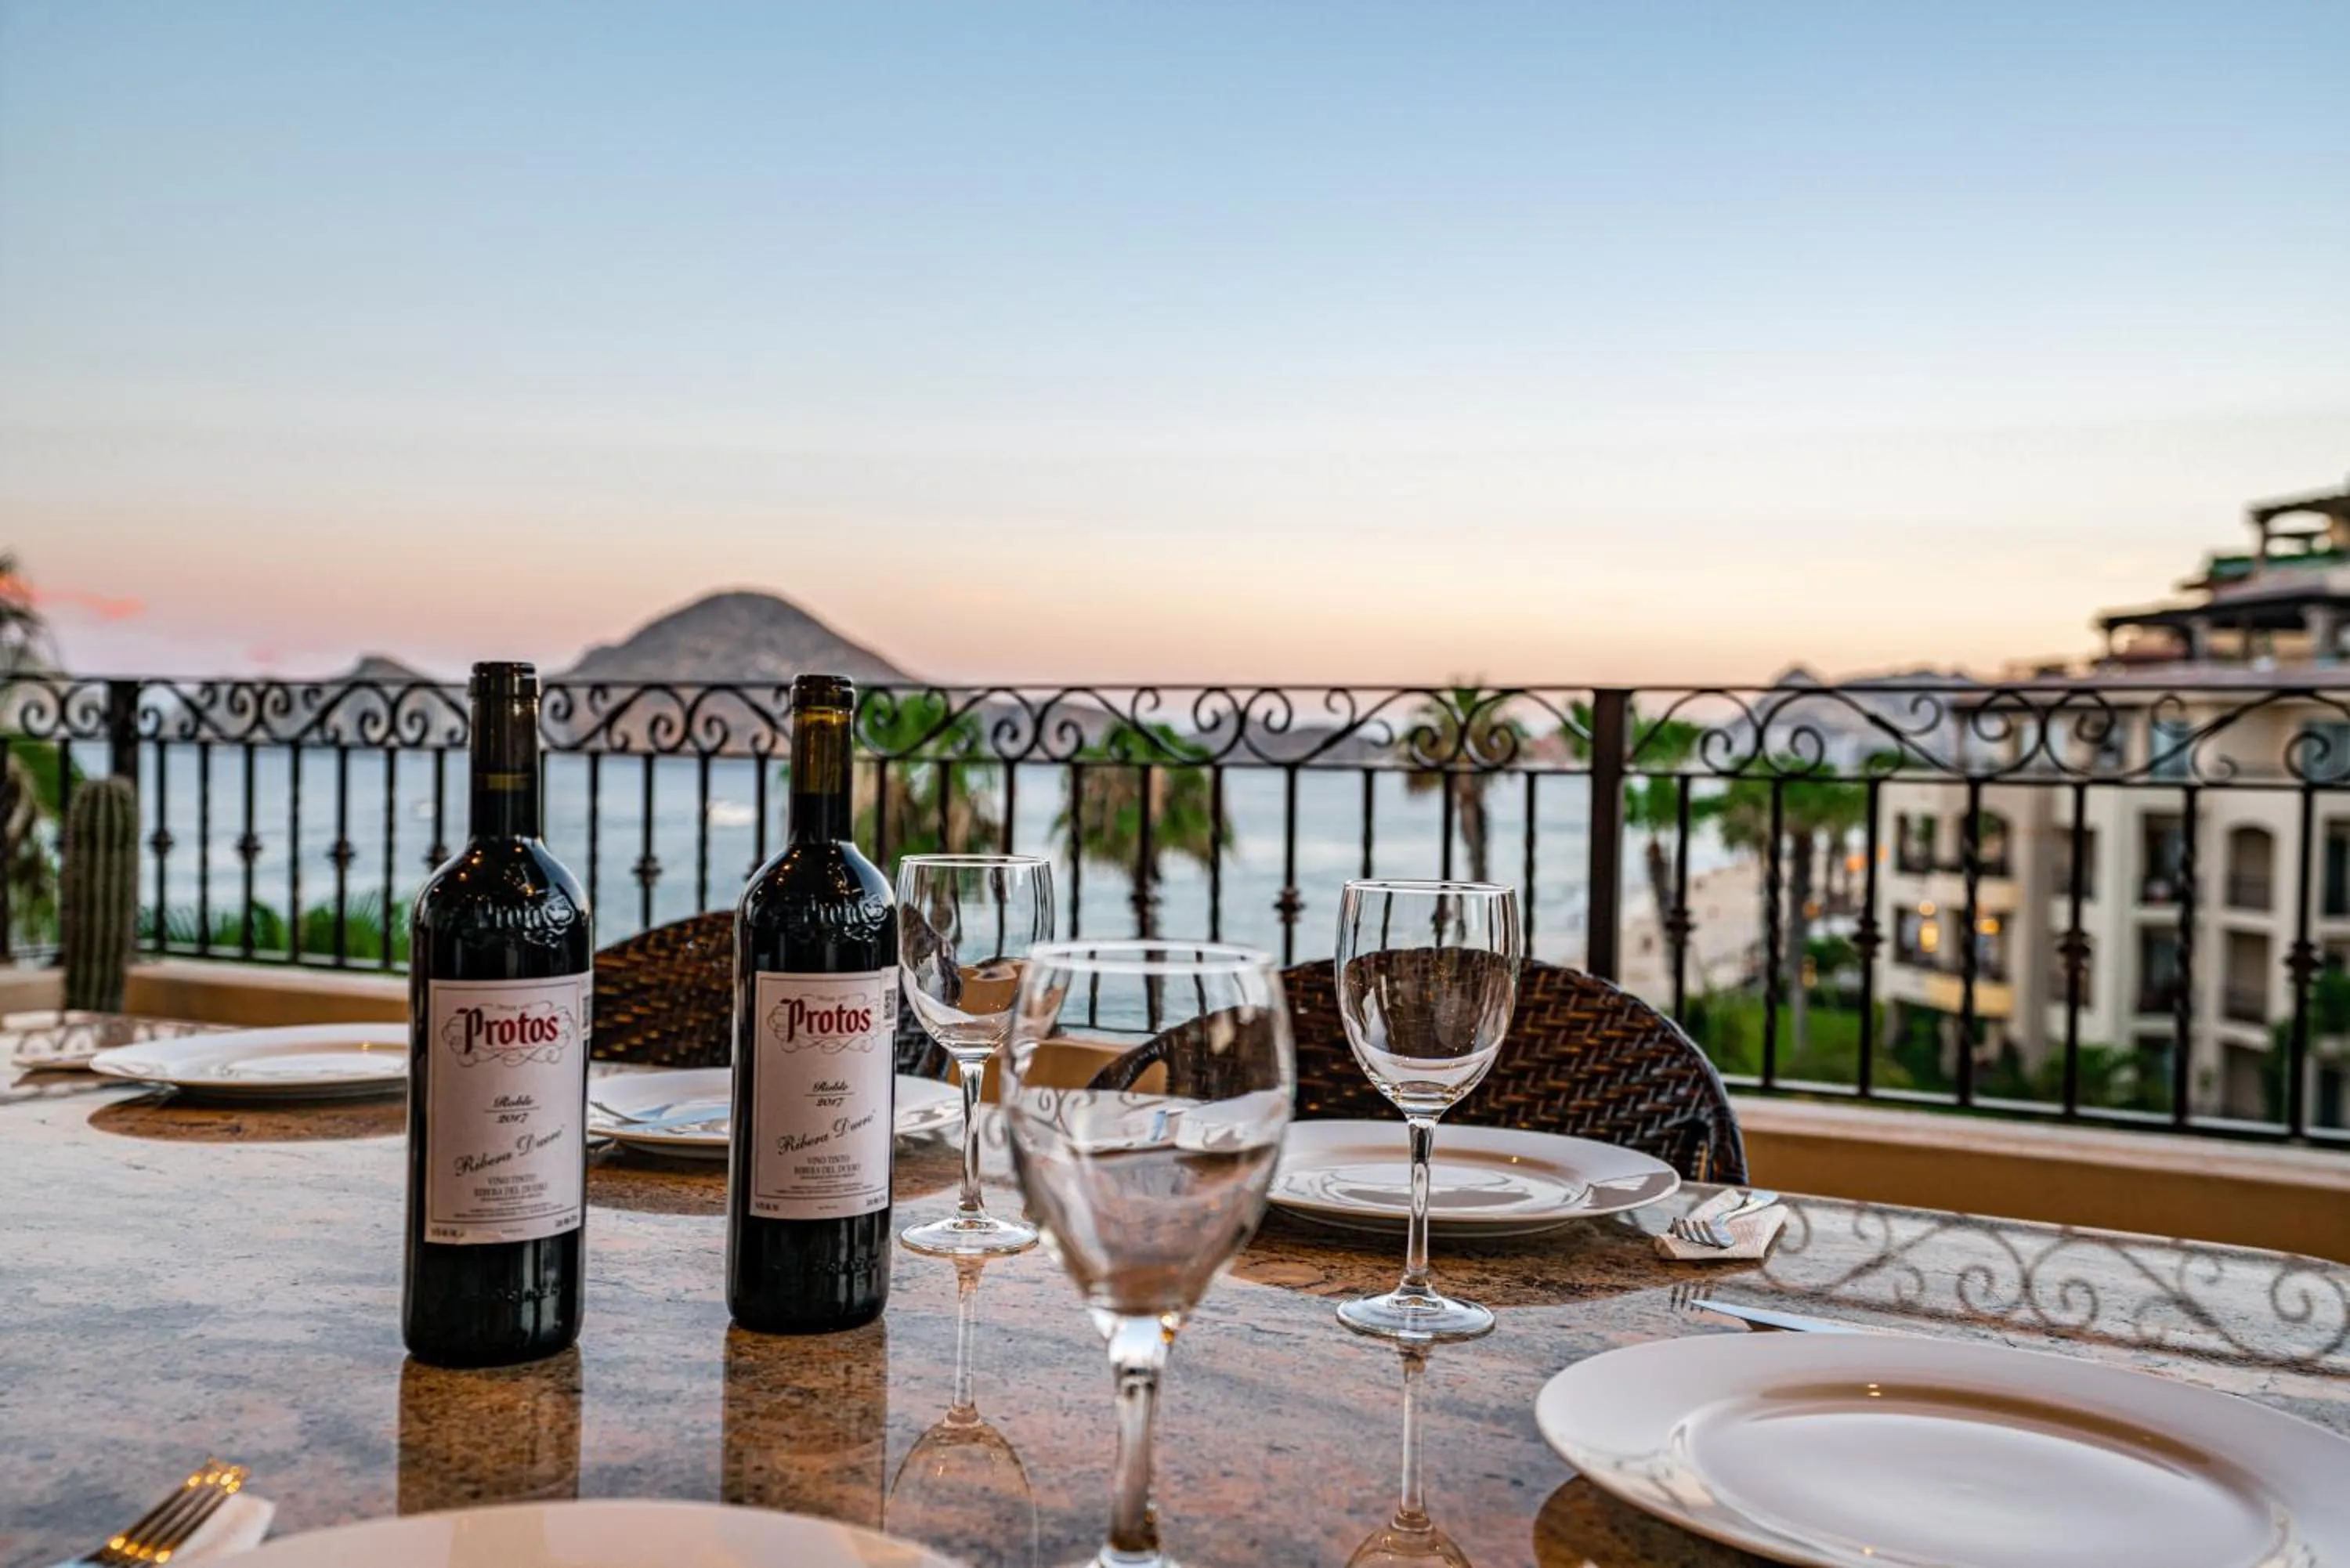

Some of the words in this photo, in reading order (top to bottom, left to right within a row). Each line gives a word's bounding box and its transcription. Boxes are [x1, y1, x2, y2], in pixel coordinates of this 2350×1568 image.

[779, 998, 872, 1042] Protos
[455, 1007, 559, 1055] Protos
[812, 1080, 849, 1092] Roble
[494, 1095, 534, 1108] Roble
[815, 1097, 845, 1107] 2017
[497, 1113, 530, 1124] 2017
[776, 1133, 830, 1155] Ribera
[454, 1151, 512, 1176] Ribera
